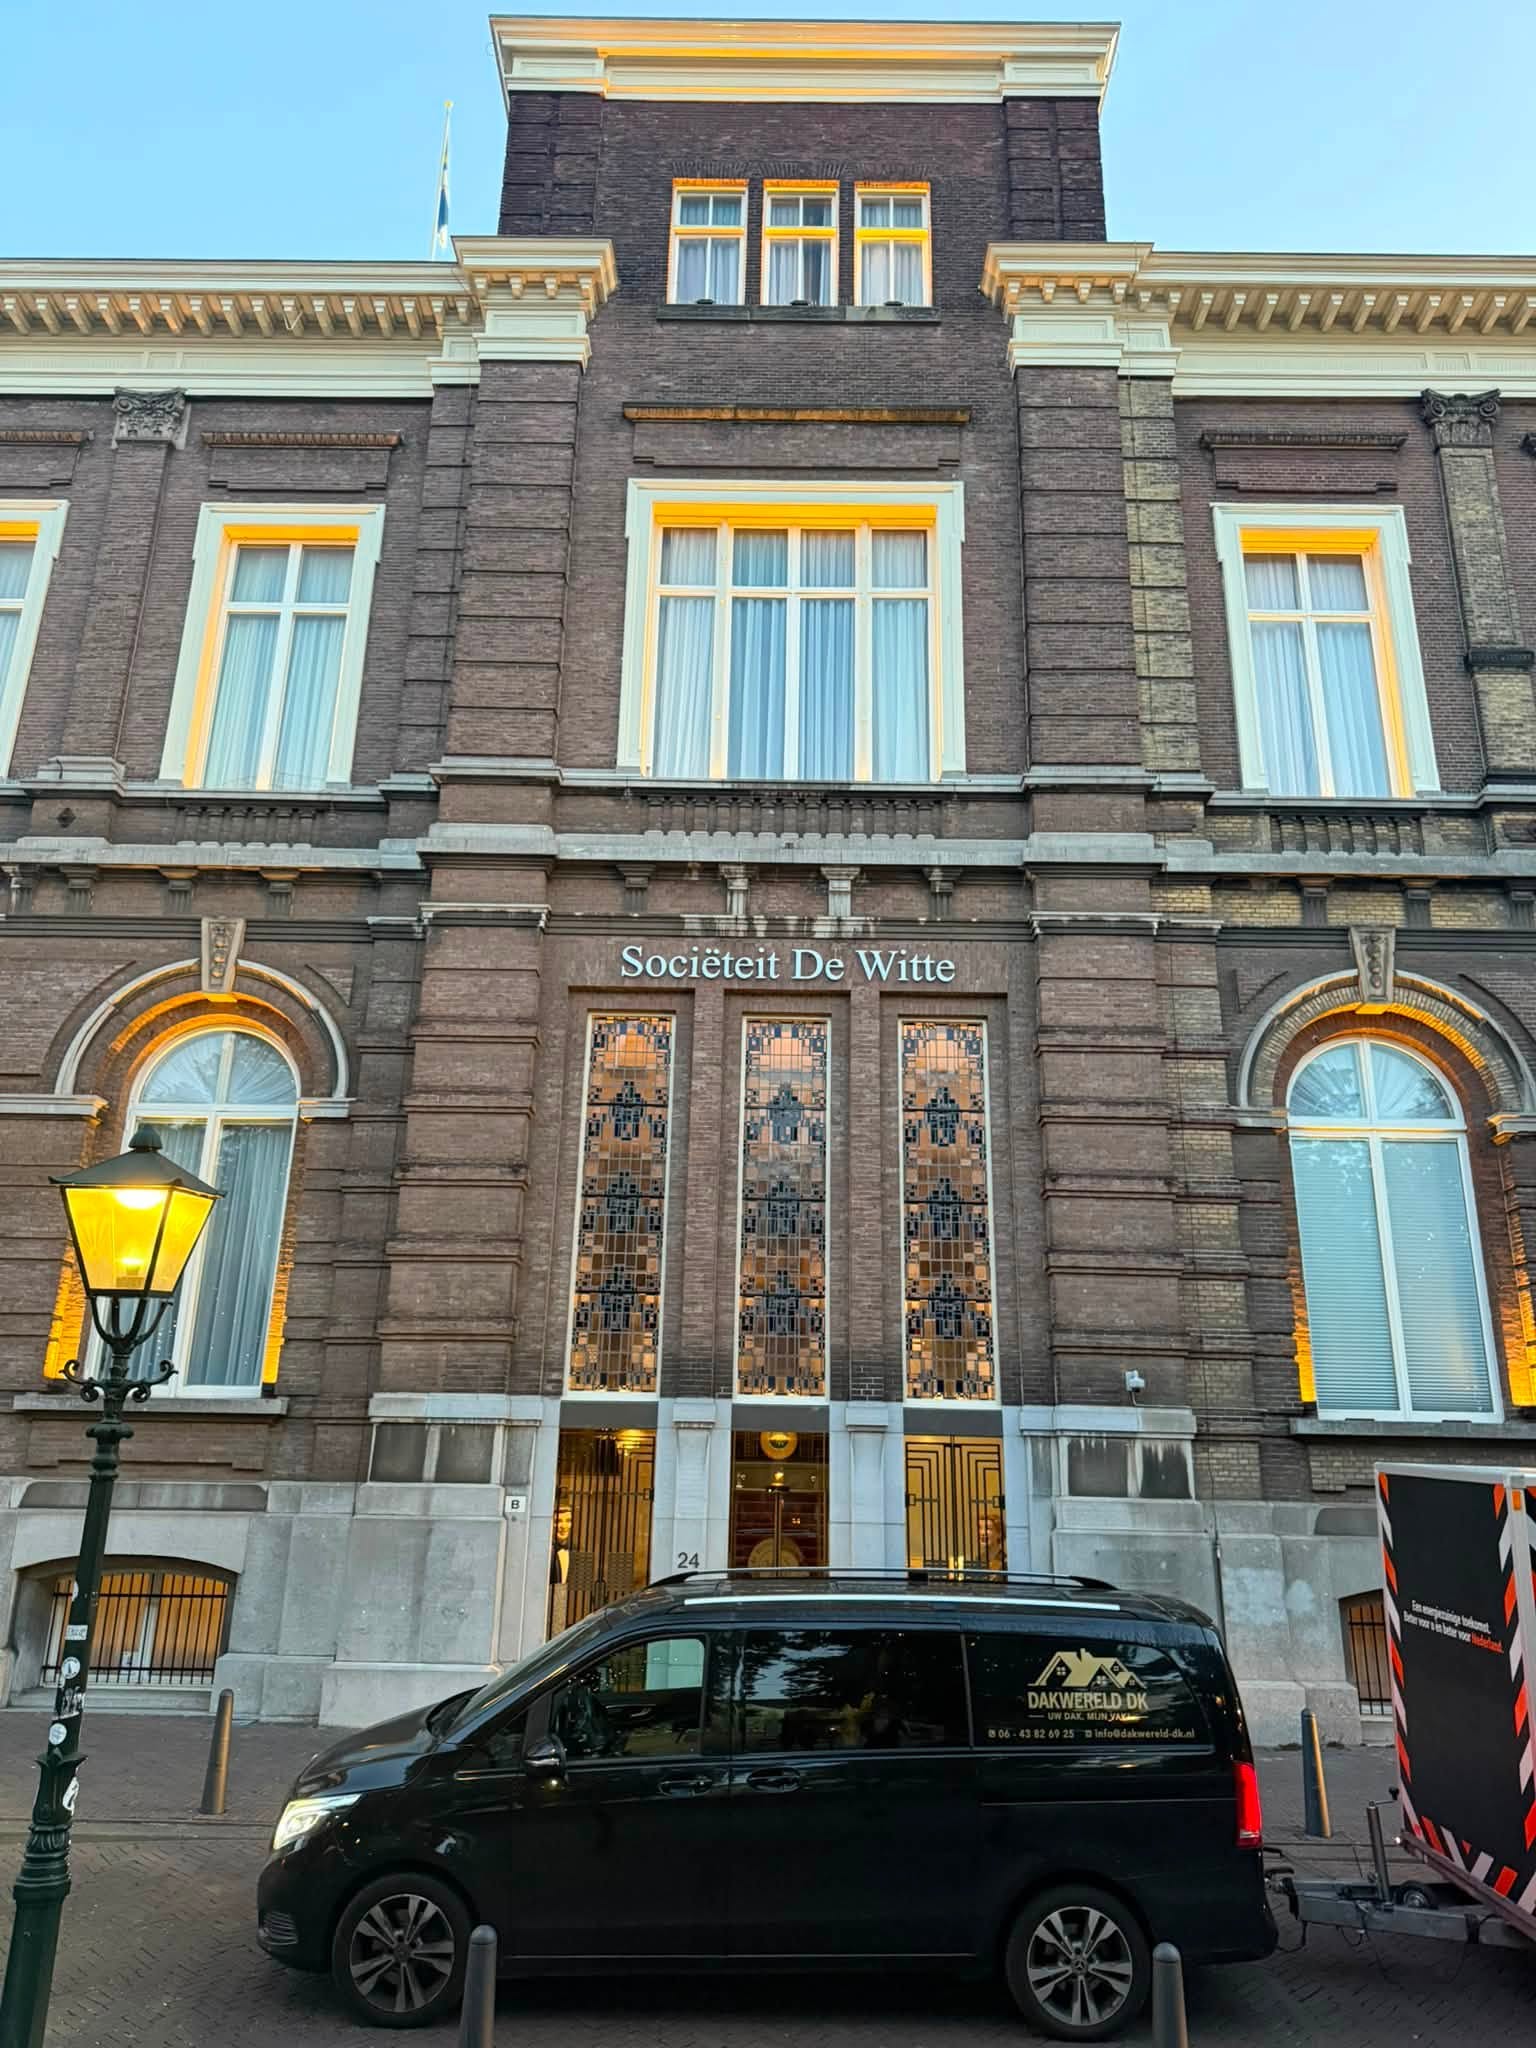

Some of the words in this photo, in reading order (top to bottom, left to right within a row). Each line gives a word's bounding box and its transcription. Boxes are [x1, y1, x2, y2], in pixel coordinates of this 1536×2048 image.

[621, 945, 781, 980] Sociëteit
[790, 948, 845, 981] De
[855, 948, 957, 983] Witte
[511, 1499, 520, 1510] B
[677, 1551, 700, 1569] 24
[1027, 1691, 1122, 1710] DAKWERELD
[1126, 1692, 1149, 1711] DK
[1047, 1712, 1061, 1721] UW
[998, 1729, 1010, 1738] 06
[1019, 1729, 1031, 1738] 43
[1033, 1729, 1046, 1739] 82
[1048, 1729, 1061, 1739] 69
[1063, 1729, 1075, 1739] 25
